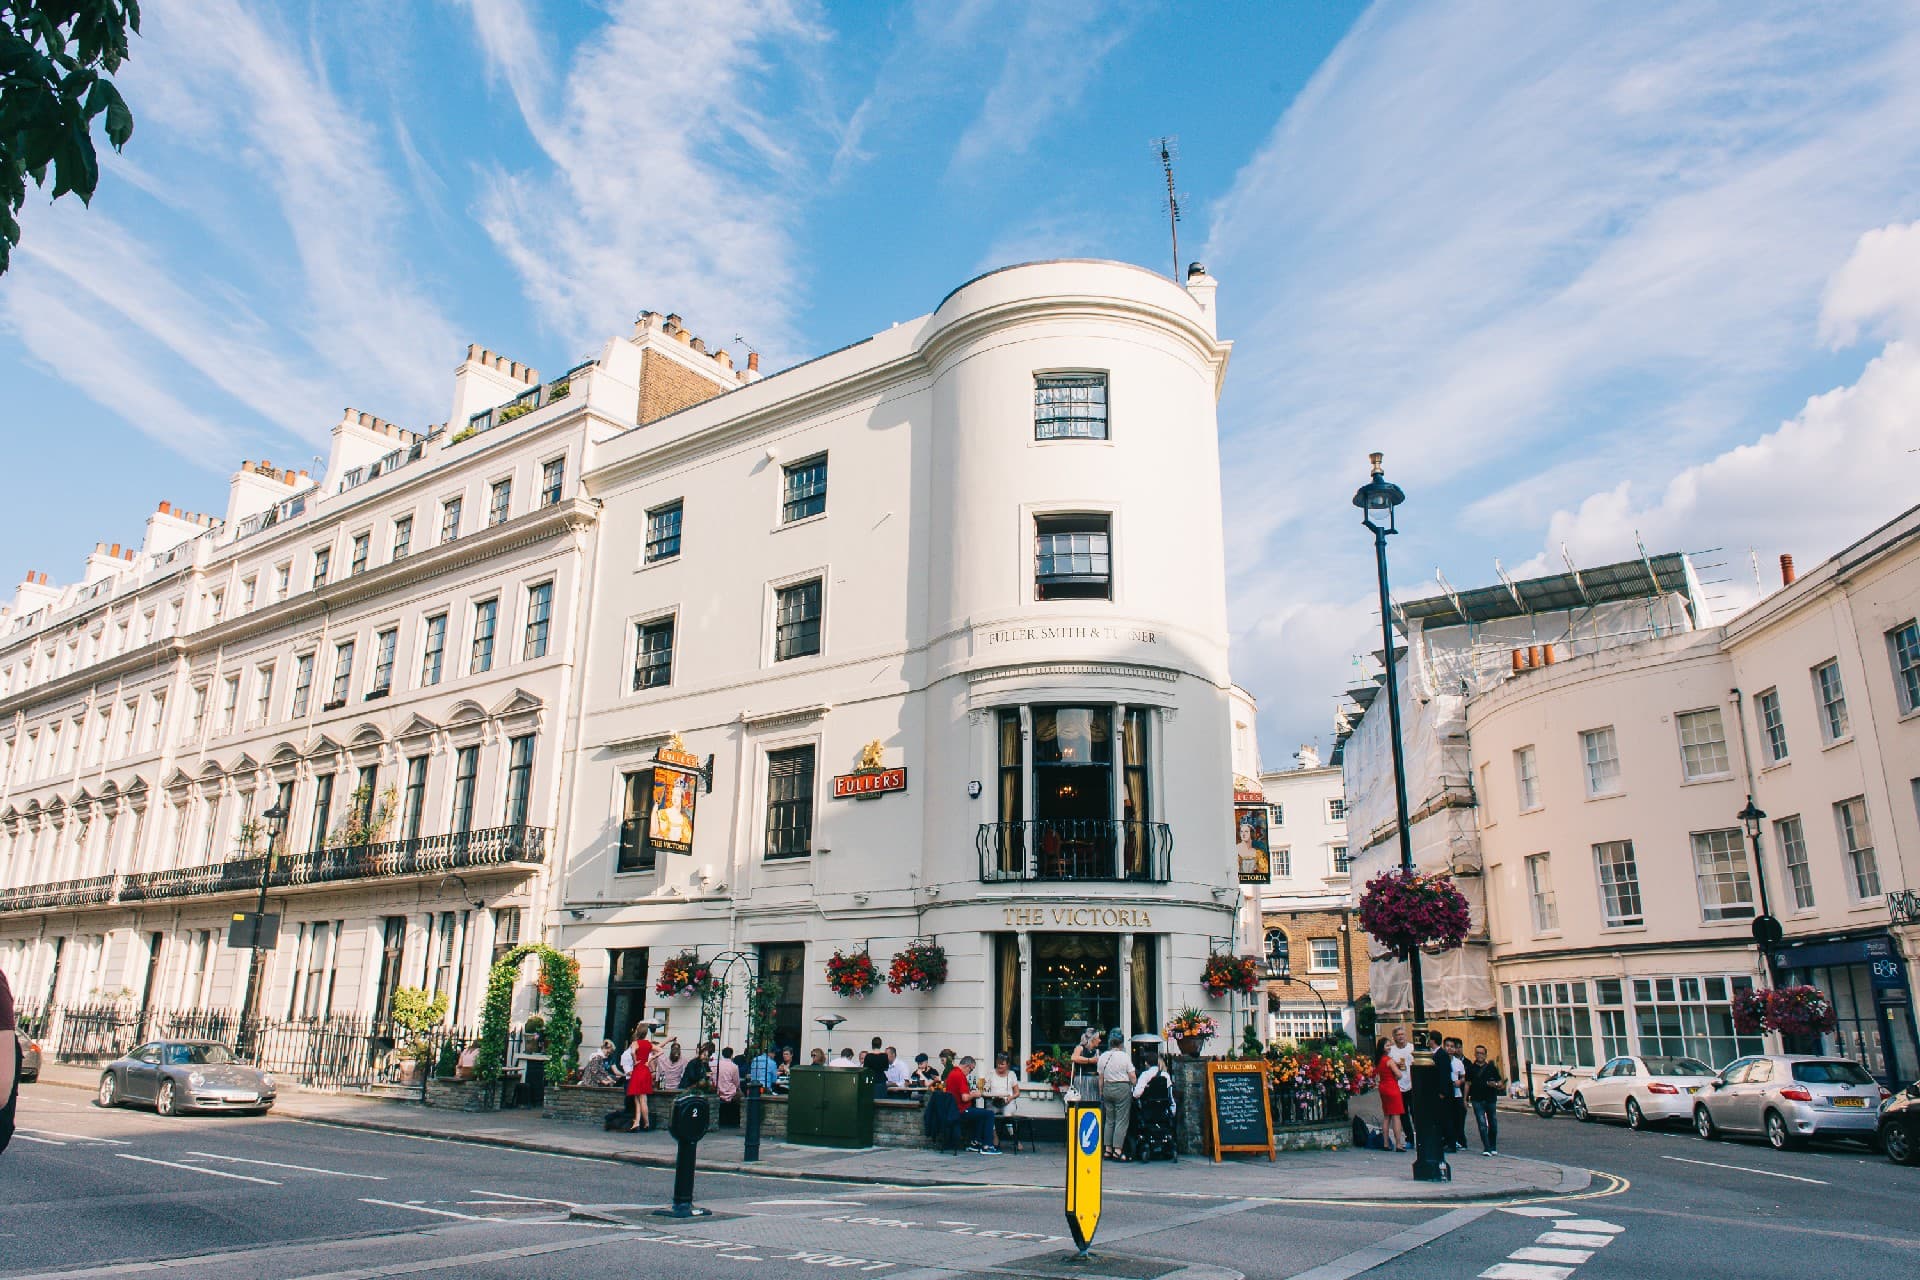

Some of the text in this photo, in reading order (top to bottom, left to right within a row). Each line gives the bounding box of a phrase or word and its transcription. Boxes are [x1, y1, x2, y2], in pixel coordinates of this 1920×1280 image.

[1041, 627, 1086, 639] SMITH
[1003, 908, 1152, 927] THE VICTORIA
[692, 1108, 698, 1118] 2
